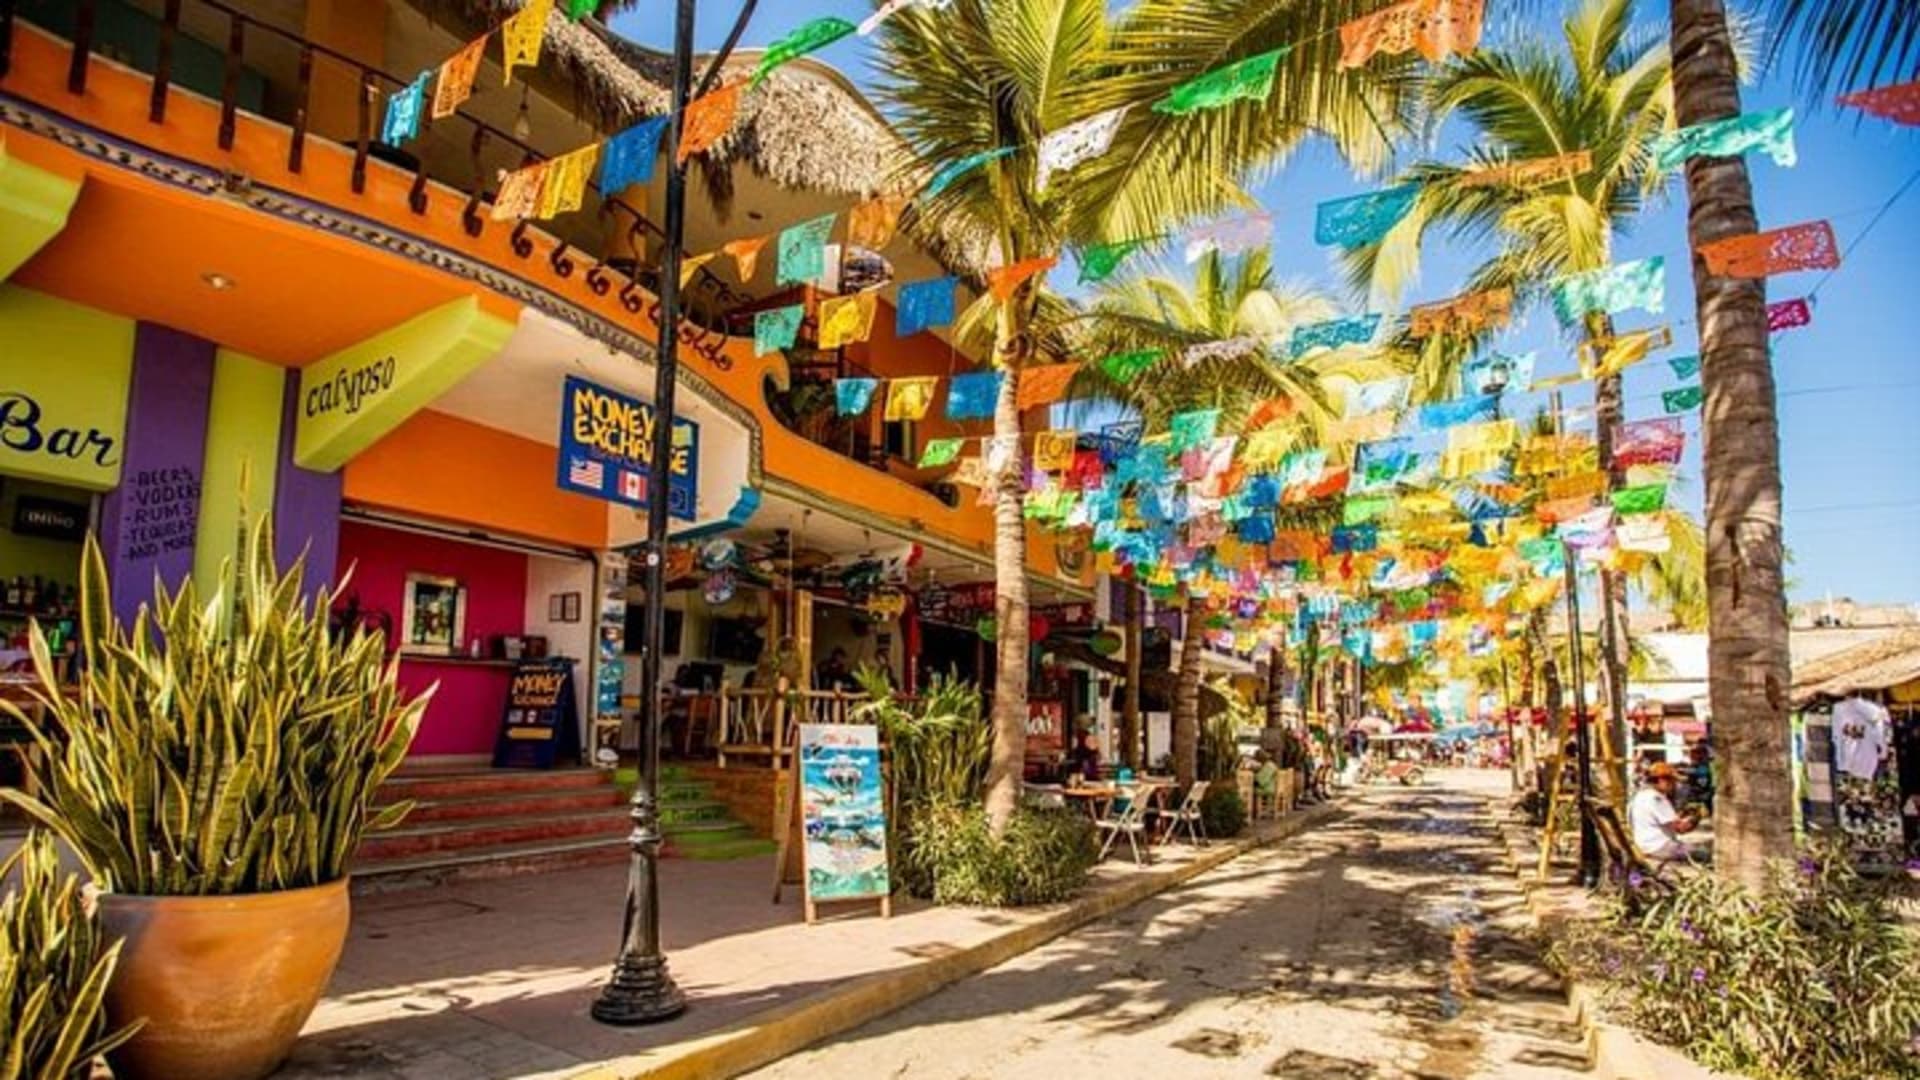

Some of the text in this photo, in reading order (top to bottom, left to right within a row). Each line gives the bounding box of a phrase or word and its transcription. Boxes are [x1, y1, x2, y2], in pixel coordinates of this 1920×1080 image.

[306, 355, 395, 418] calypso
[573, 387, 656, 443] MONEY
[0, 391, 117, 468] Bar
[511, 671, 568, 700] MONEY
